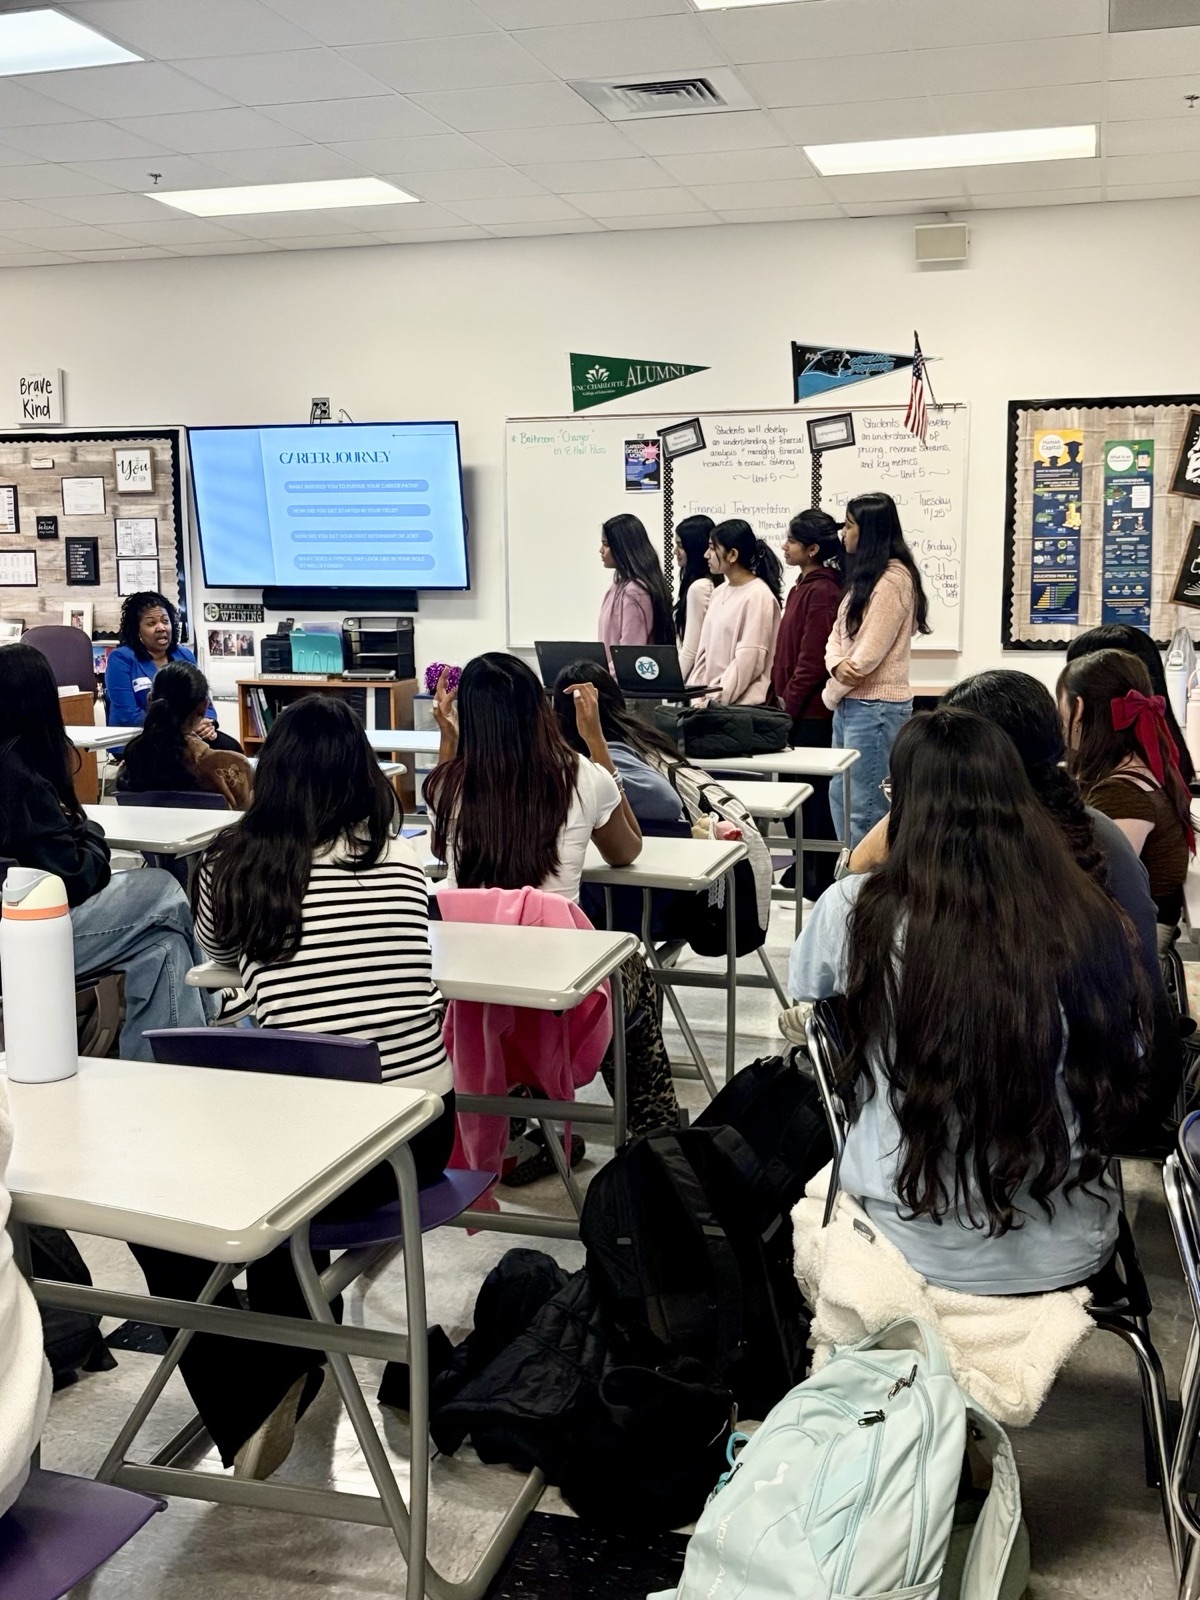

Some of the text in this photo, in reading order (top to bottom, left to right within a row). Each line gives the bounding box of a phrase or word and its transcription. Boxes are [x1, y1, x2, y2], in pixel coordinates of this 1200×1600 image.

[626, 364, 686, 388] ALUMNI
[20, 378, 52, 396] Brave
[586, 380, 625, 390] CHARLOTTE
[22, 396, 50, 420] Kind
[714, 424, 788, 436] Students will develop
[862, 418, 951, 430] Students evelop
[520, 433, 555, 444] Bathroom
[929, 430, 940, 441] of
[722, 436, 768, 450] understanding
[768, 437, 776, 446] of
[778, 434, 804, 446] financial
[590, 444, 606, 454] Pass
[710, 446, 805, 460] analysis managing financial
[279, 451, 391, 464] CAREER JOURNEY
[118, 460, 150, 480] You
[769, 459, 796, 471] solvency
[860, 458, 918, 472] and key metrics
[752, 472, 778, 484] Unit 5
[900, 467, 926, 479] Unit 5
[689, 500, 790, 514] Financial Interpretation
[914, 490, 952, 512] Tuesday
[758, 520, 787, 531] Monday
[942, 581, 959, 590] days
[946, 589, 958, 598] left
[220, 610, 262, 622] WHINING
